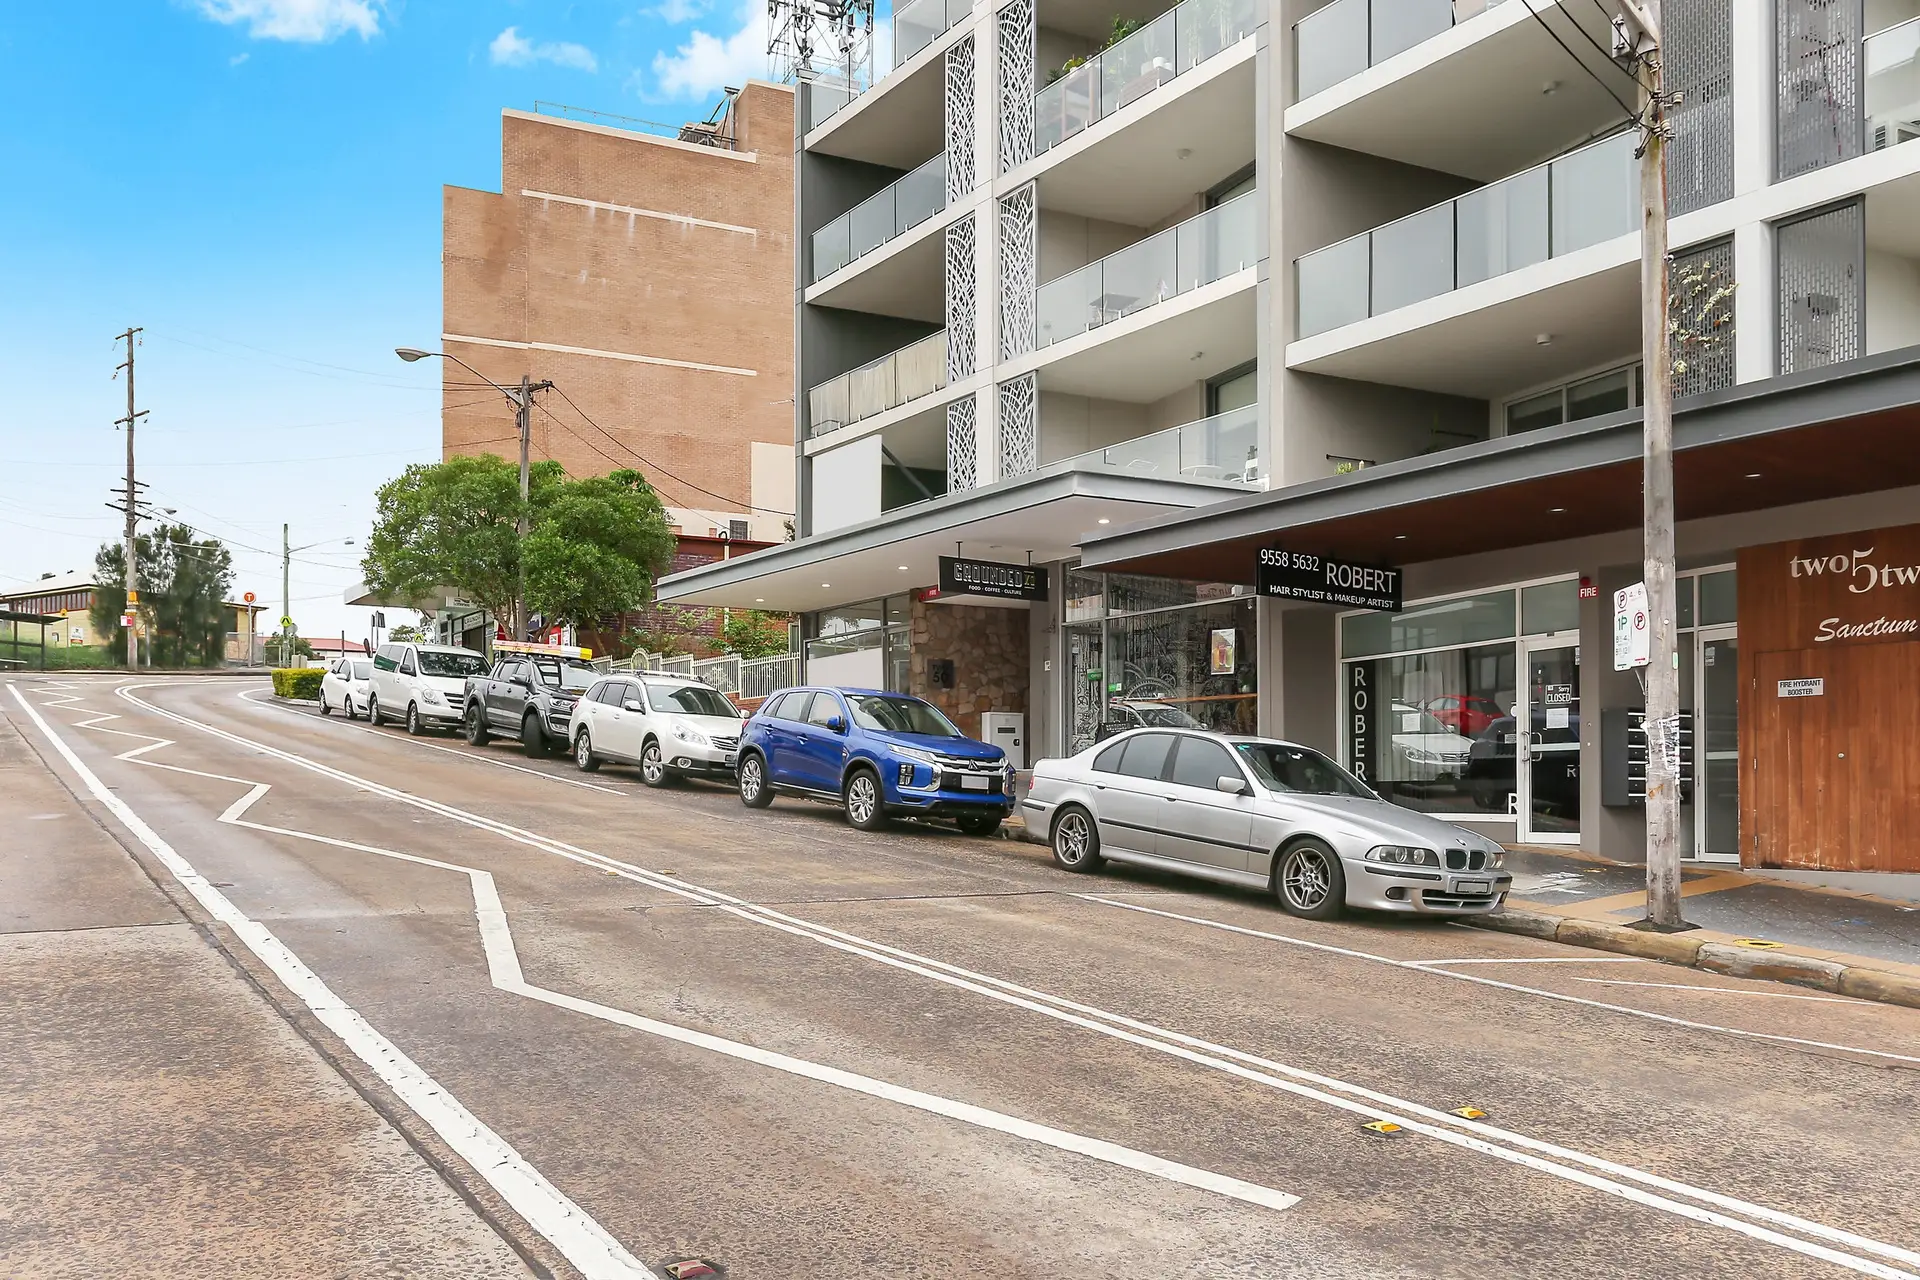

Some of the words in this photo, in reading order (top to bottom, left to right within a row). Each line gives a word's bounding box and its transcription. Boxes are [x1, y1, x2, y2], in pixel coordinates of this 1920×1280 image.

[1260, 548, 1289, 568] 9558
[1292, 553, 1320, 572] 5632
[953, 562, 1023, 588] GROUNDED
[1326, 562, 1397, 594] ROBERT
[1003, 588, 1022, 596] CULTURE
[1269, 584, 1291, 596] HAIR
[1292, 587, 1325, 600] STYLIST
[1326, 592, 1333, 601] &
[1334, 593, 1366, 605] MAKEUP
[1367, 598, 1394, 609] ARTIST
[1579, 587, 1597, 598] FIRE
[1814, 616, 1918, 643] Sanctum
[1788, 688, 1813, 696] BOOSTER
[1793, 680, 1821, 688] HYDRANT
[1547, 693, 1571, 703] CLOSED
